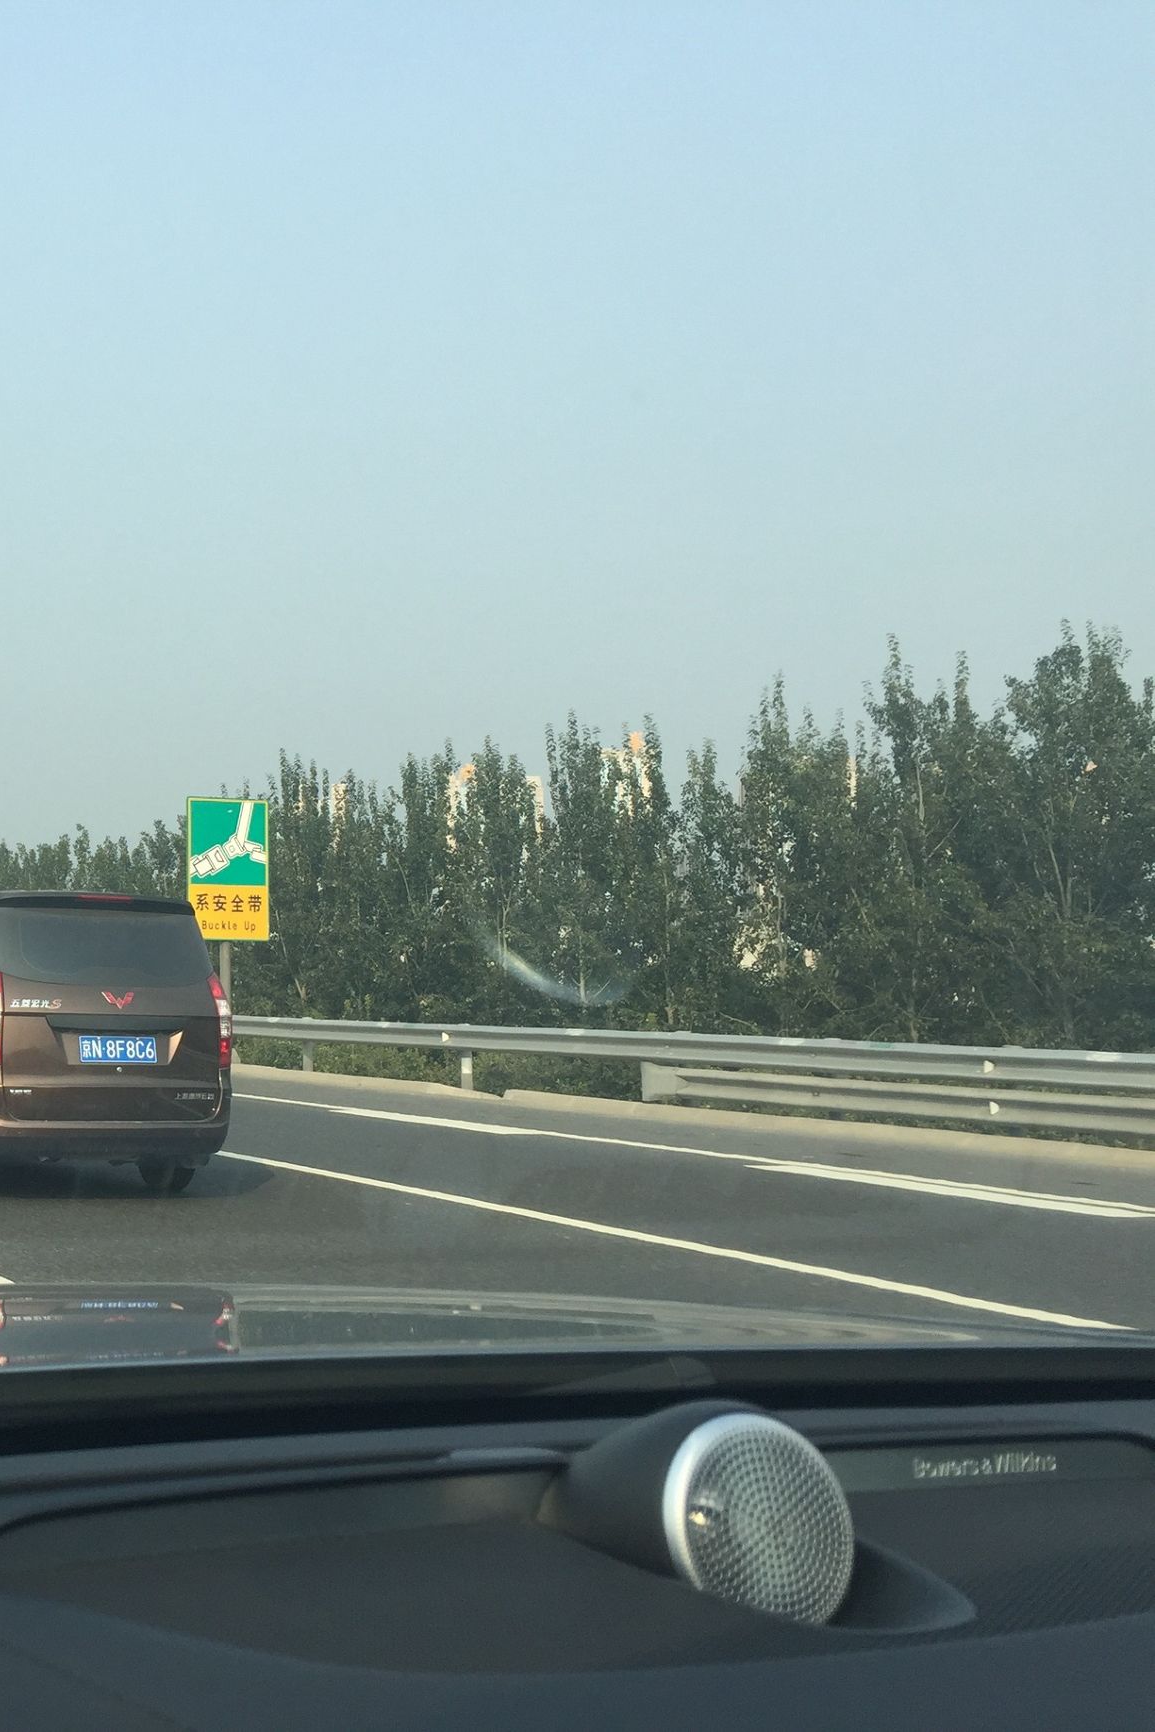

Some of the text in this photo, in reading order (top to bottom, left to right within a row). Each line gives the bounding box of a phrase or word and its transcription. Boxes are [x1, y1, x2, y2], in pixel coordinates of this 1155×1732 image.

[196, 893, 262, 912] 系安全带
[202, 920, 256, 932] Buckle Up
